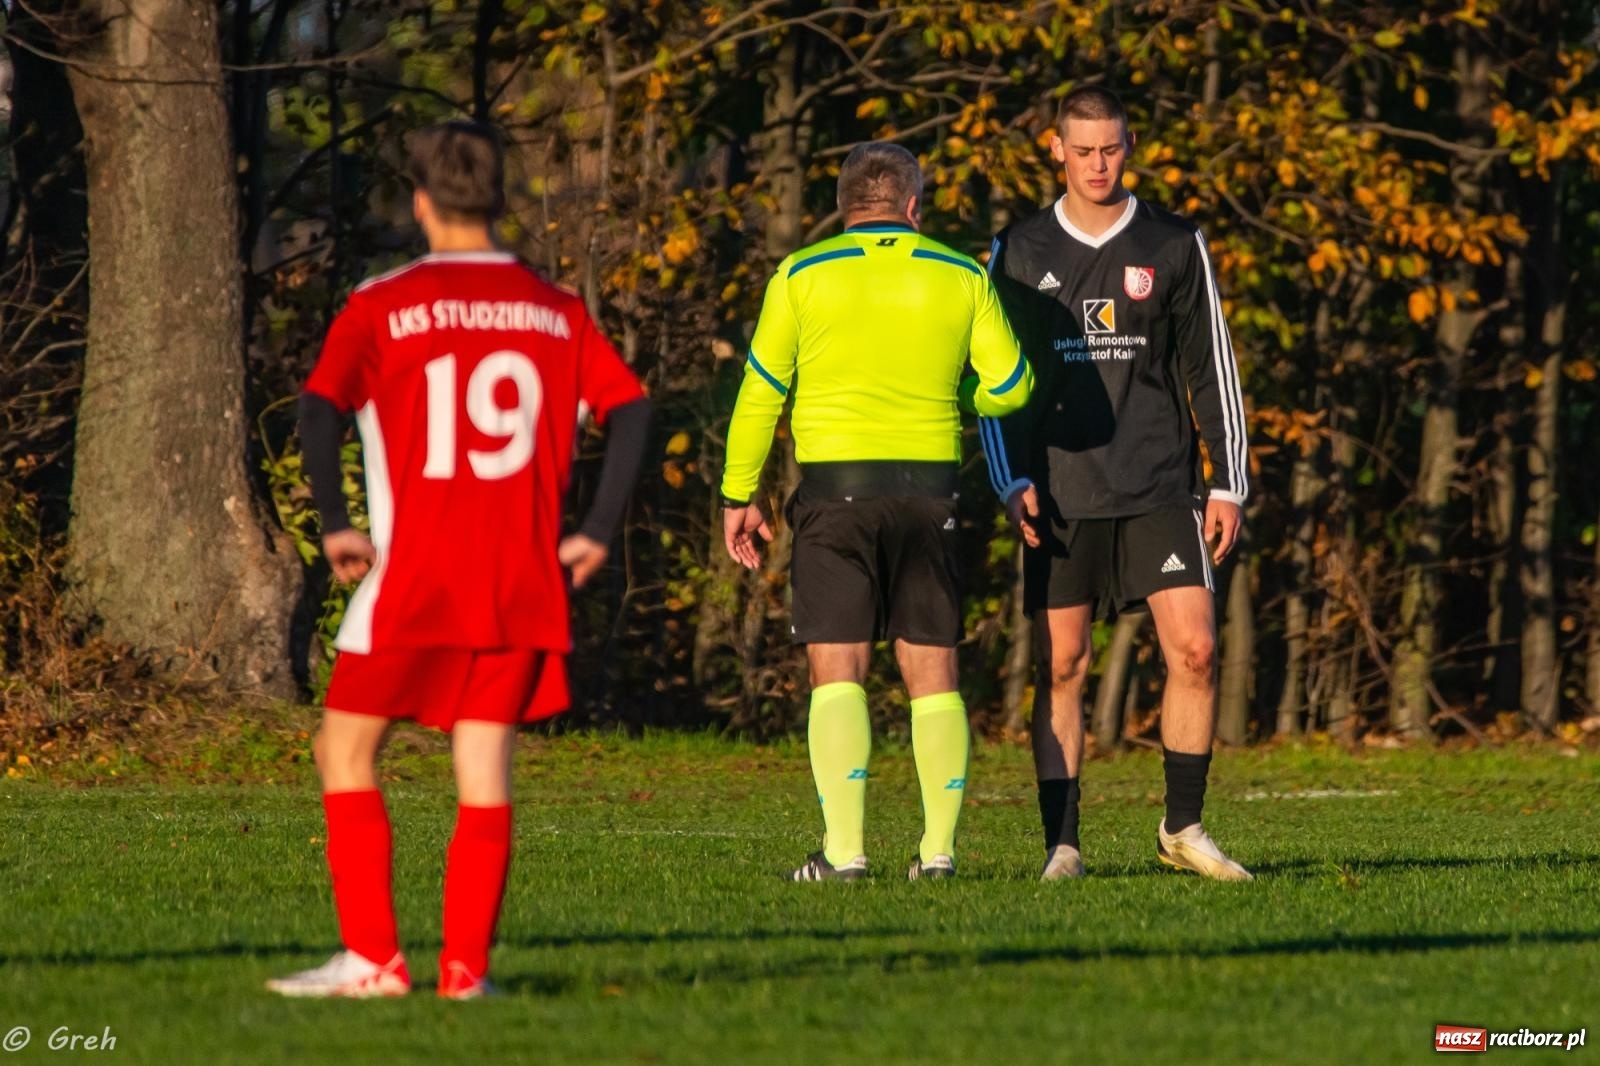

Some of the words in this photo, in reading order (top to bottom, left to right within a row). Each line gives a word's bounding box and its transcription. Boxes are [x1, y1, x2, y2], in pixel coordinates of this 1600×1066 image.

[388, 302, 431, 340] LKS
[431, 299, 571, 340] STUDZIENNA
[1063, 347, 1111, 362] Krzysztof
[1088, 334, 1147, 347] Remontowe
[422, 349, 544, 480] 19
